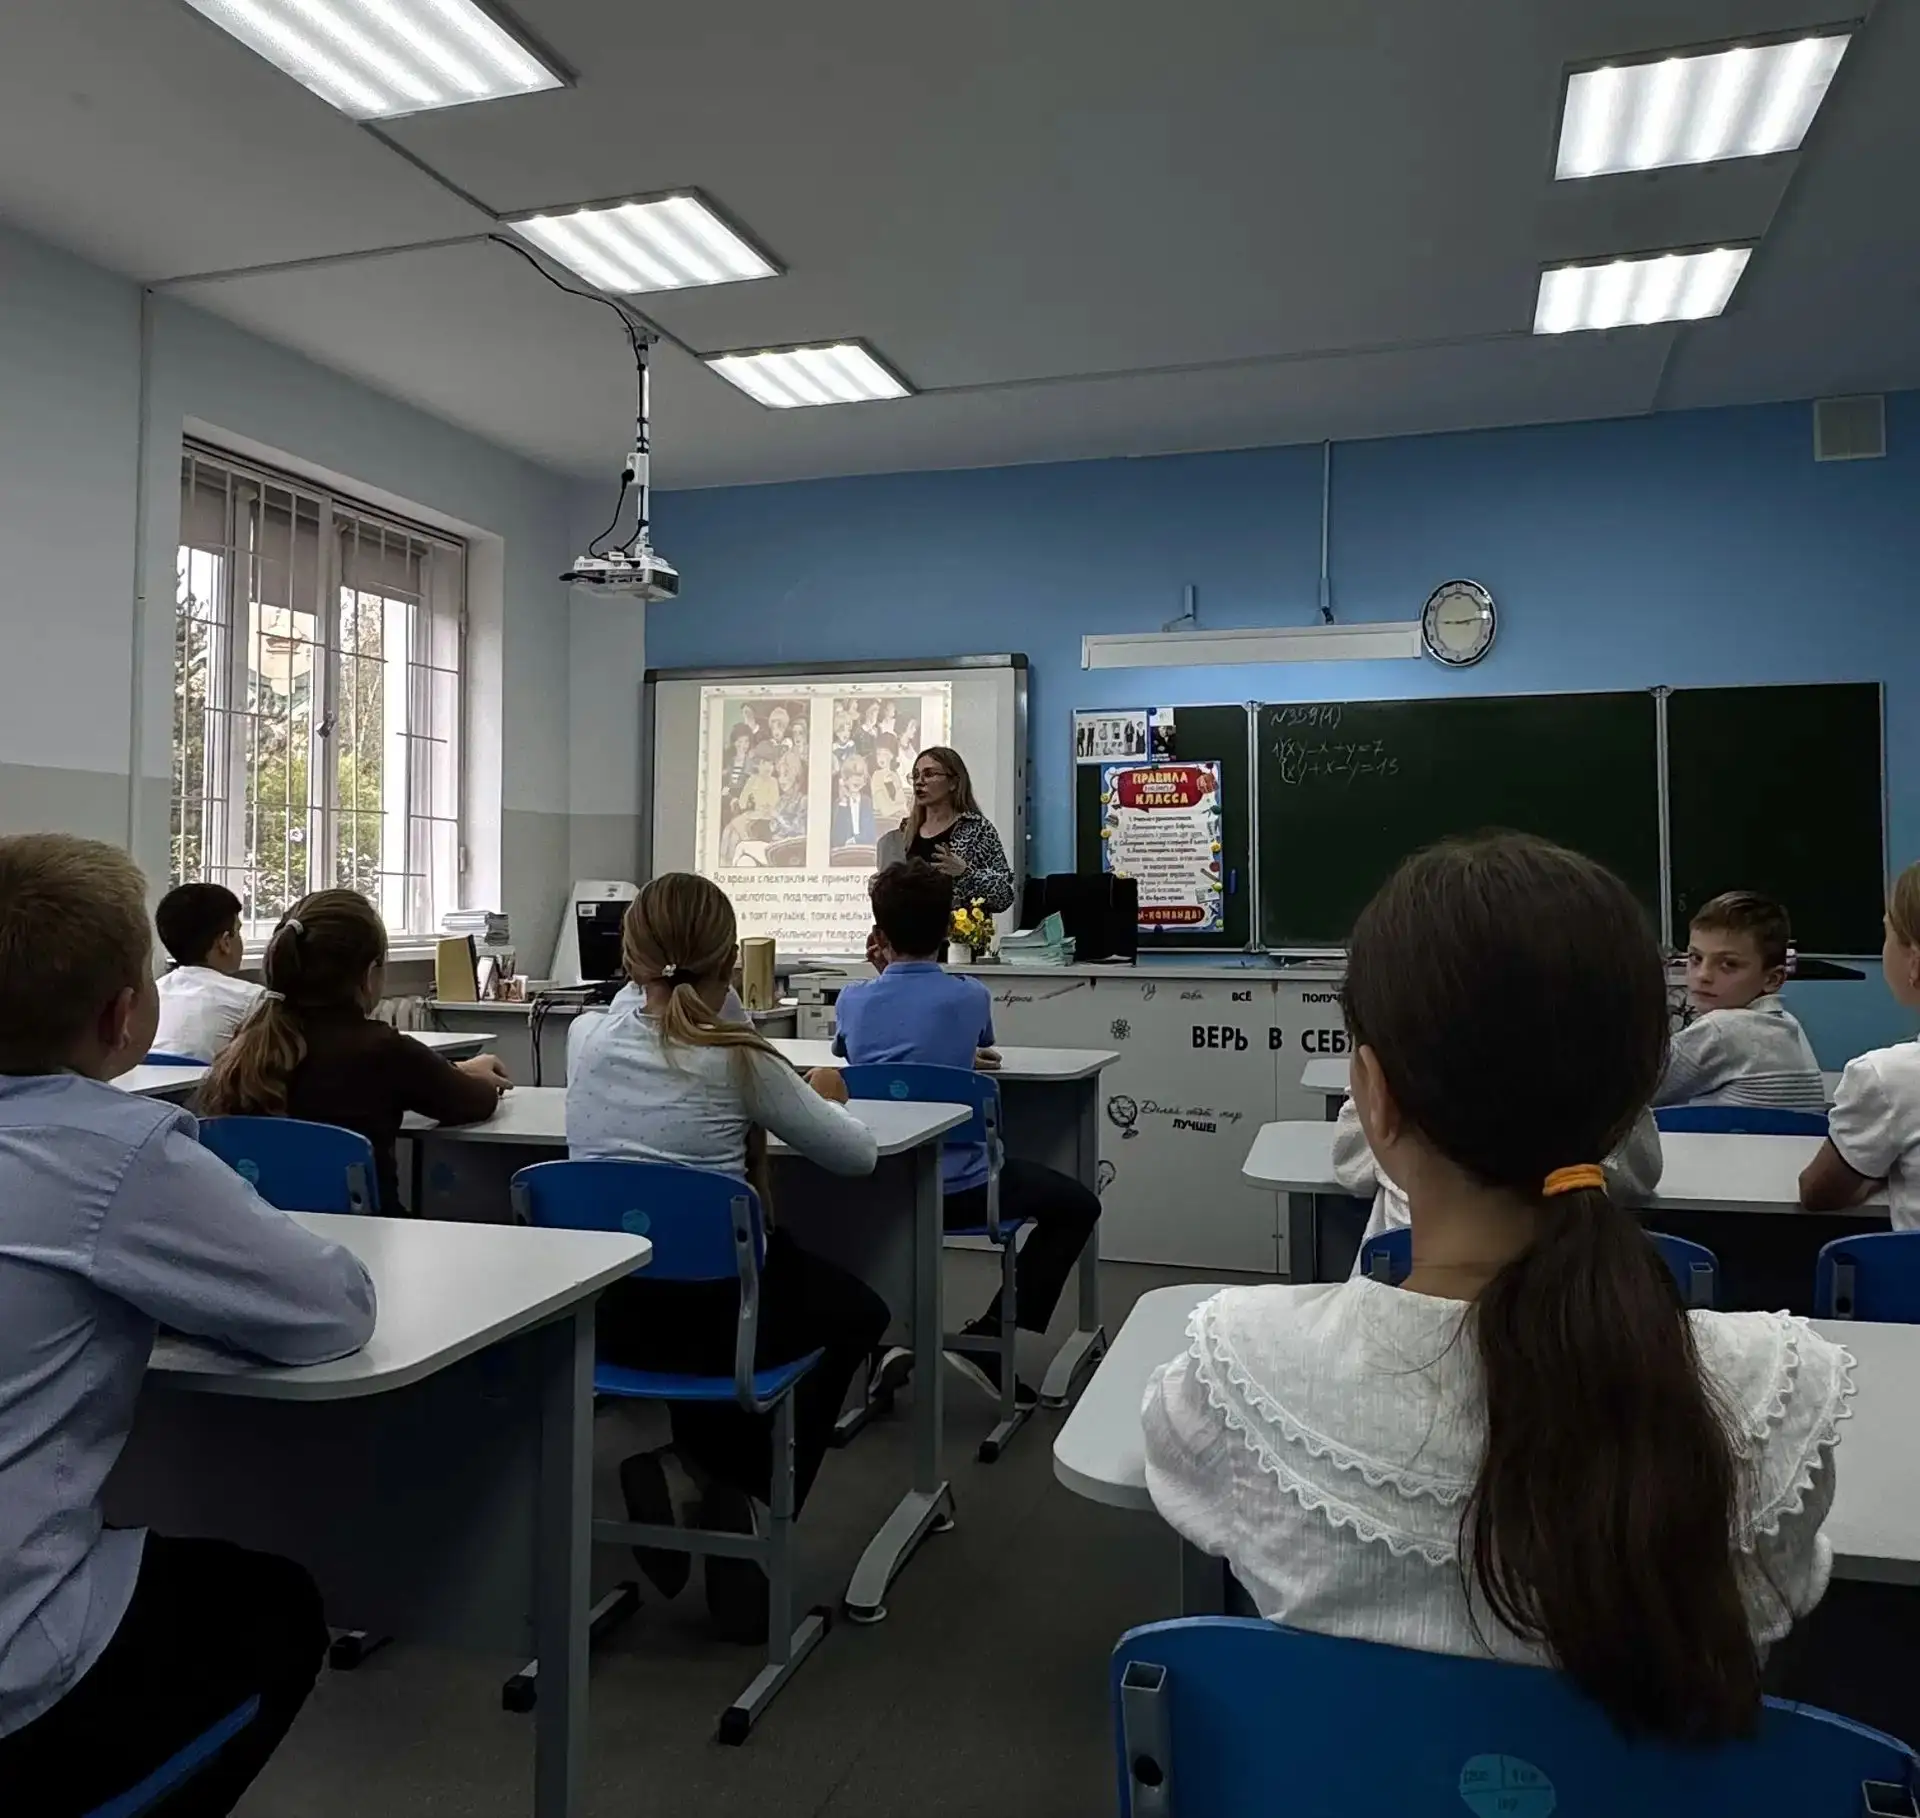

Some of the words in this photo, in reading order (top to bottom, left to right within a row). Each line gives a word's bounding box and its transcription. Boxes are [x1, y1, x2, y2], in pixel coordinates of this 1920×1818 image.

[1132, 773, 1188, 784] ПРАВИЛА
[1135, 793, 1188, 804] КЛАССА
[727, 875, 755, 887] время
[757, 875, 805, 883] спектакля
[807, 875, 818, 883] не
[822, 875, 861, 887] принято
[811, 912, 837, 920] также
[1192, 1026, 1249, 1051] ВЕРЬ
[1269, 1027, 1283, 1050] В
[1172, 1118, 1217, 1133] ЛУЧШЕ!
